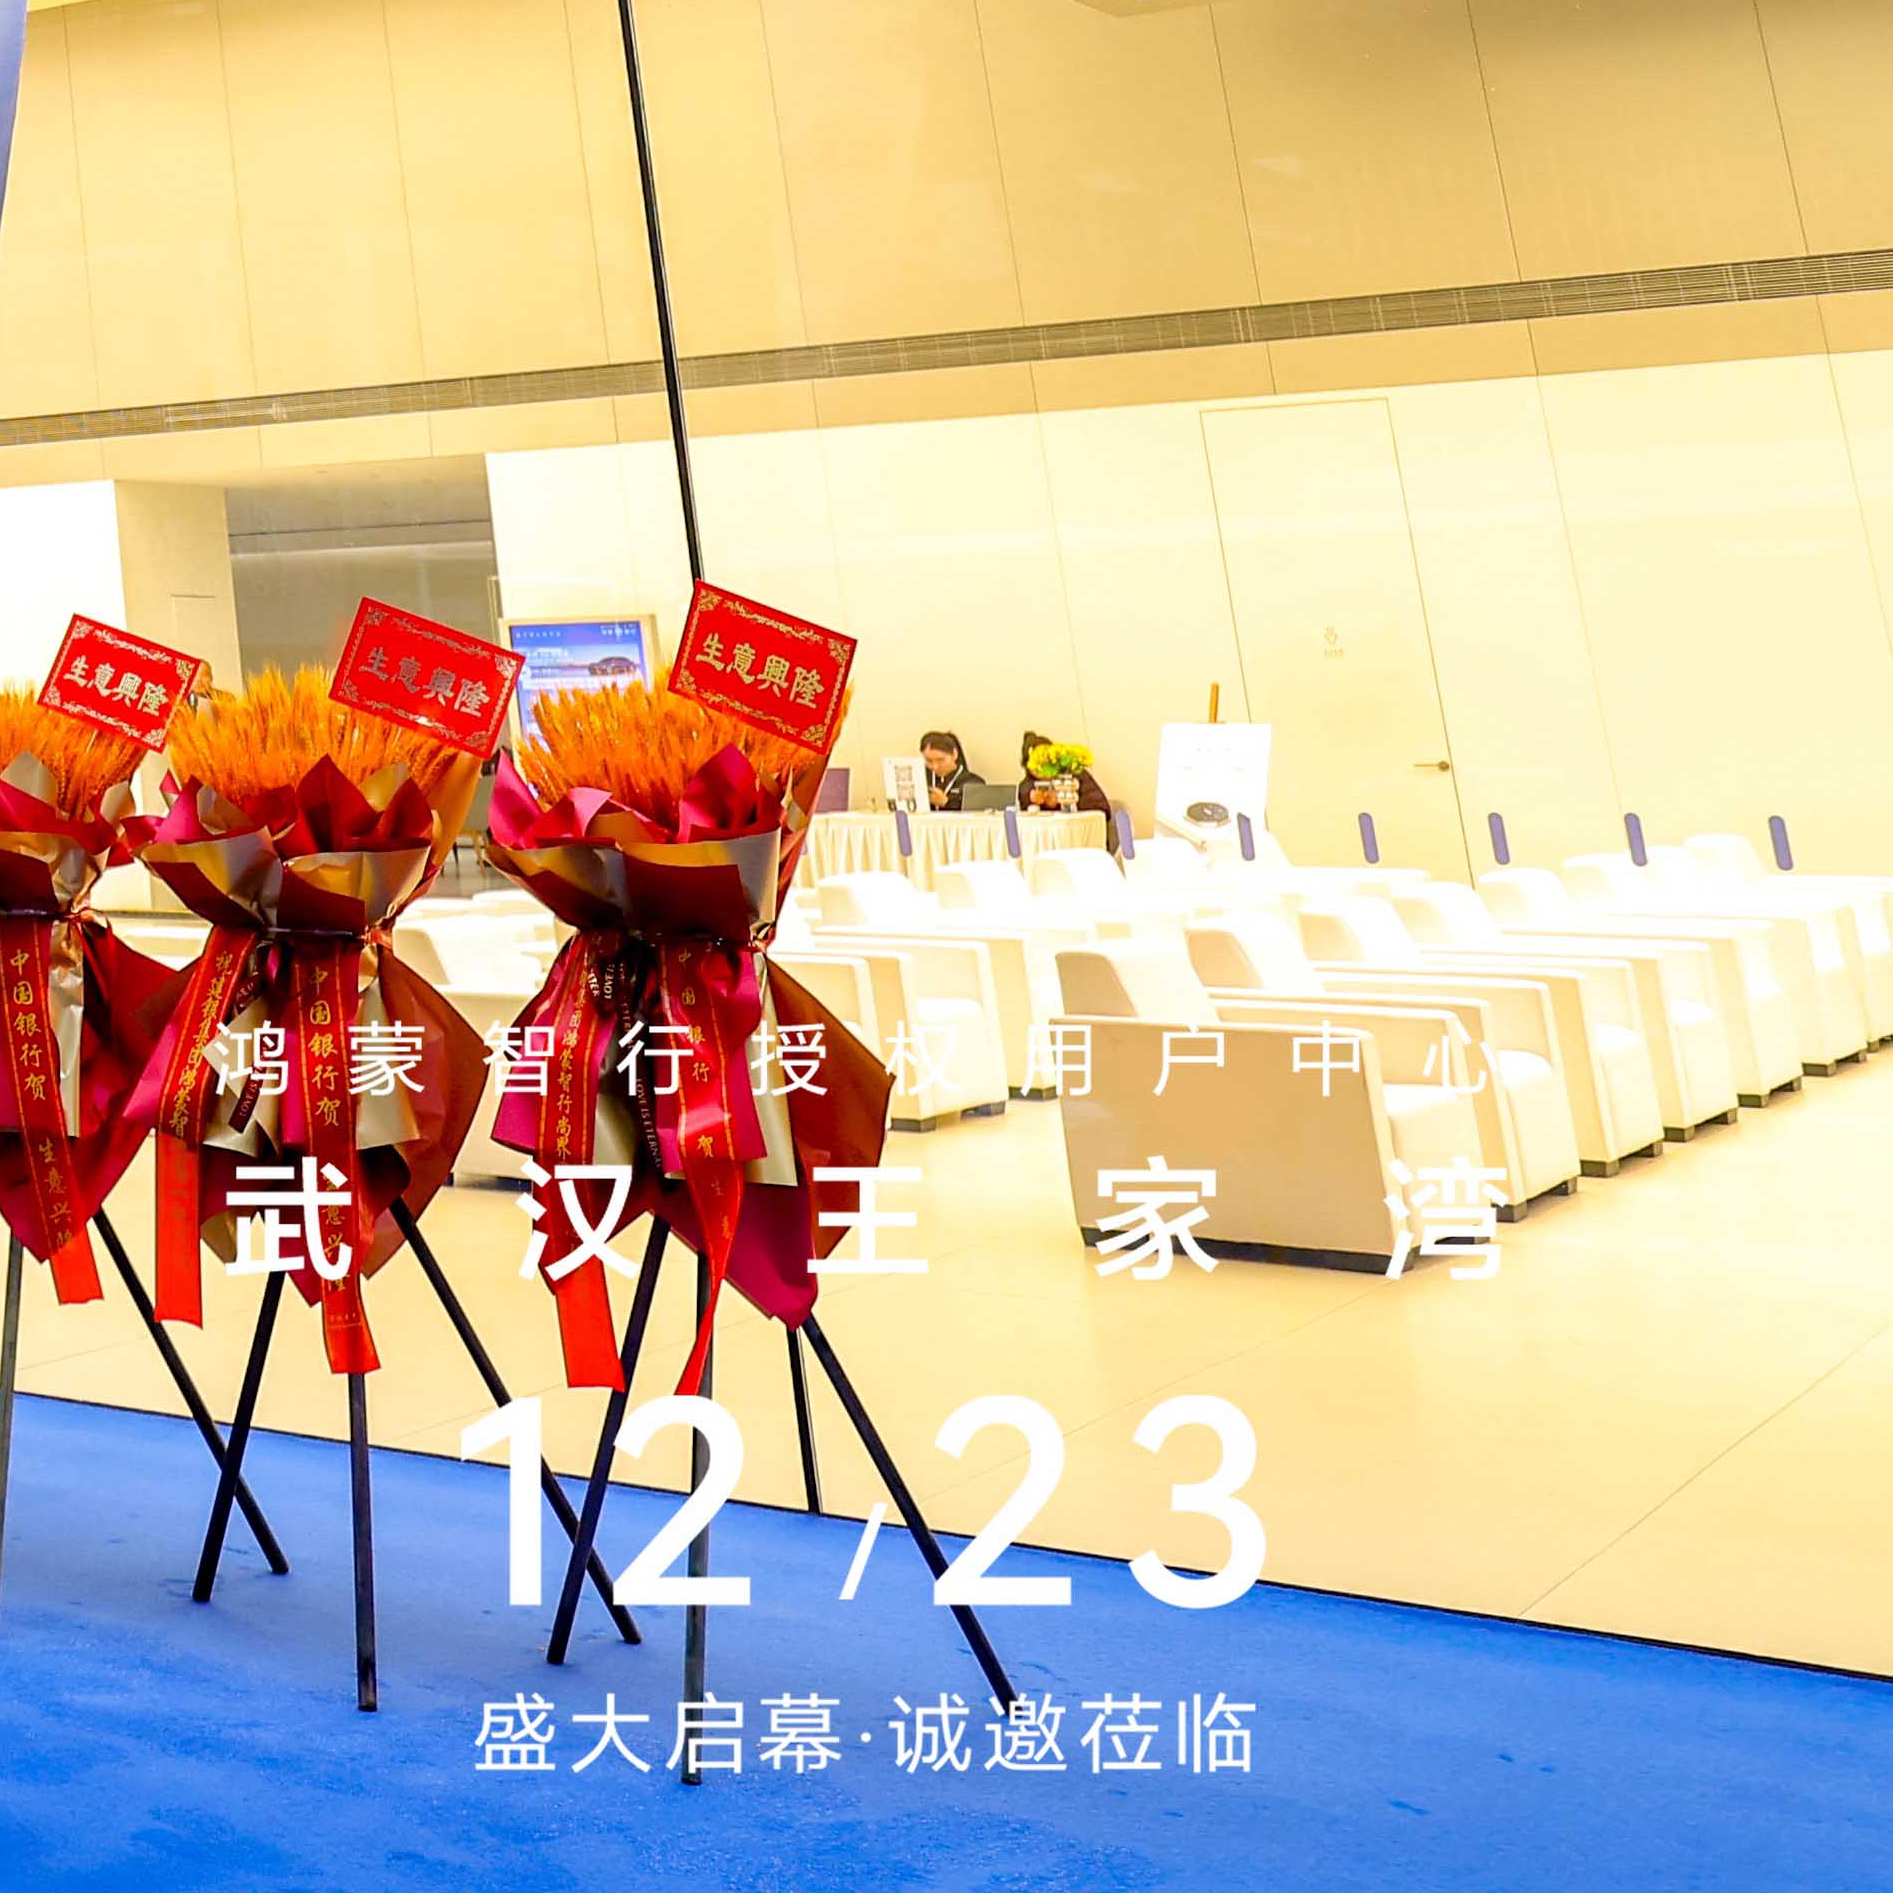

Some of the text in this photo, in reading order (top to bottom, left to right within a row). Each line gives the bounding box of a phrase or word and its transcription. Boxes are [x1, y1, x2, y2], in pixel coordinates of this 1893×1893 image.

[10, 949, 46, 1101] 中国银行贺
